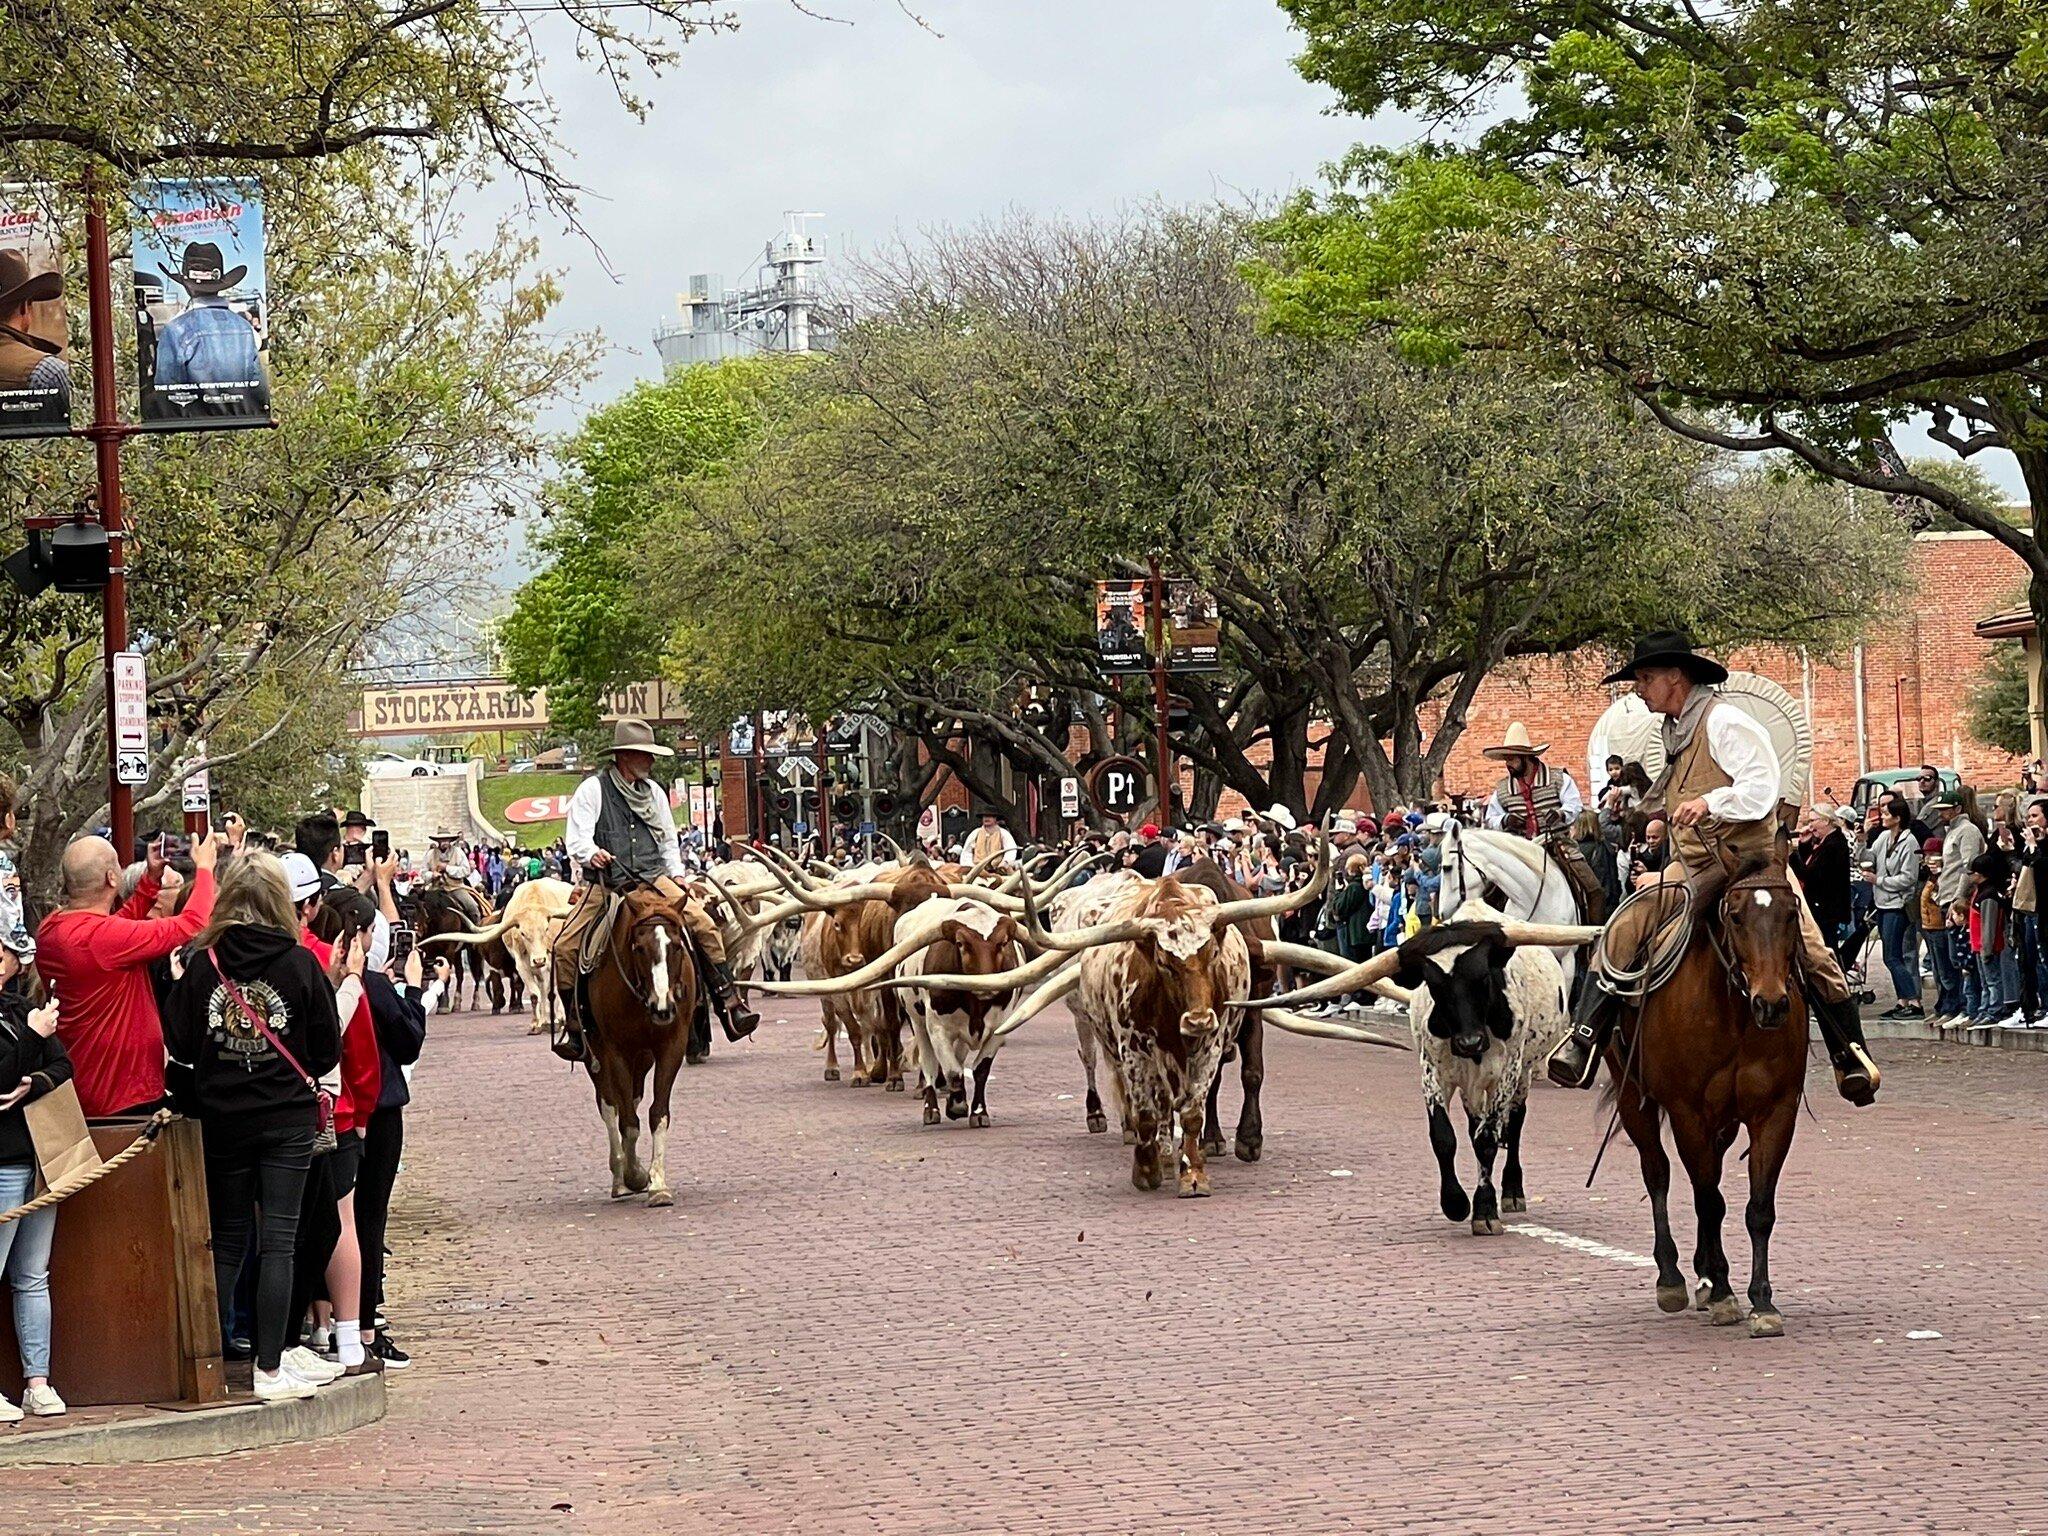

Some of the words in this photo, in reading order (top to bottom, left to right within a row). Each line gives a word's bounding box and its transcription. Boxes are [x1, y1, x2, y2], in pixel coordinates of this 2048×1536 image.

[168, 383, 199, 391] OFFICIAL
[118, 680, 144, 690] PARKING
[119, 693, 143, 703] STOPPING
[374, 690, 535, 725] STOCKYARDS
[119, 717, 145, 726] STANDING
[1107, 772, 1125, 805] P
